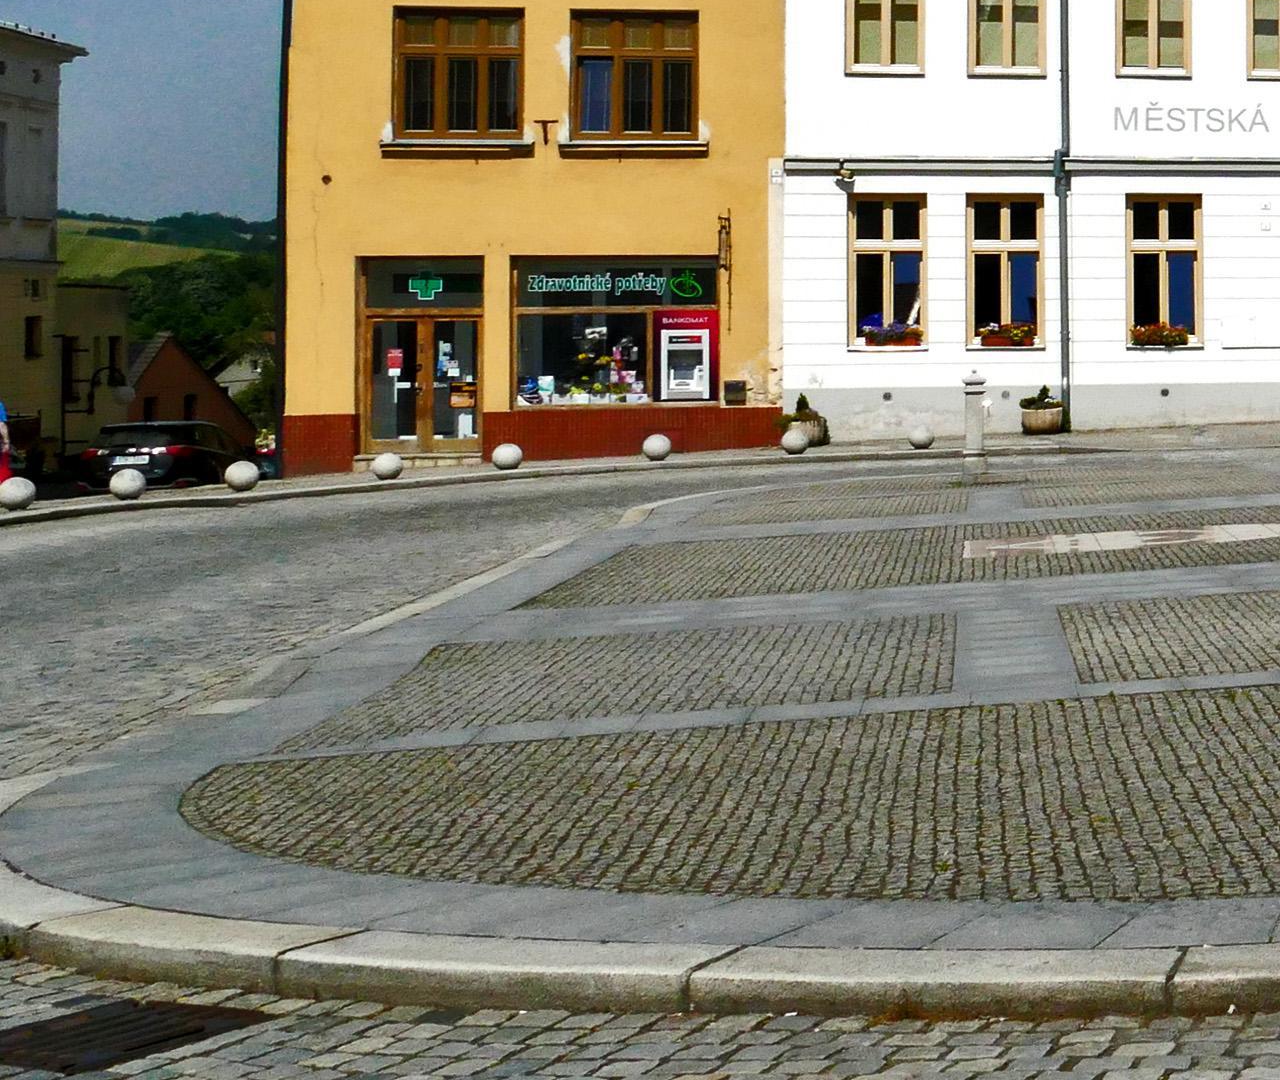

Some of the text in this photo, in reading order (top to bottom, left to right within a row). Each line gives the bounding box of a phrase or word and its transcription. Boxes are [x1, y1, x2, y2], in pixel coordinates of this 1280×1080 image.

[1113, 101, 1270, 134] MĚSTSKÁ
[528, 271, 667, 296] Zdravotnické potřeby
[661, 316, 710, 325] BANKOMAT
